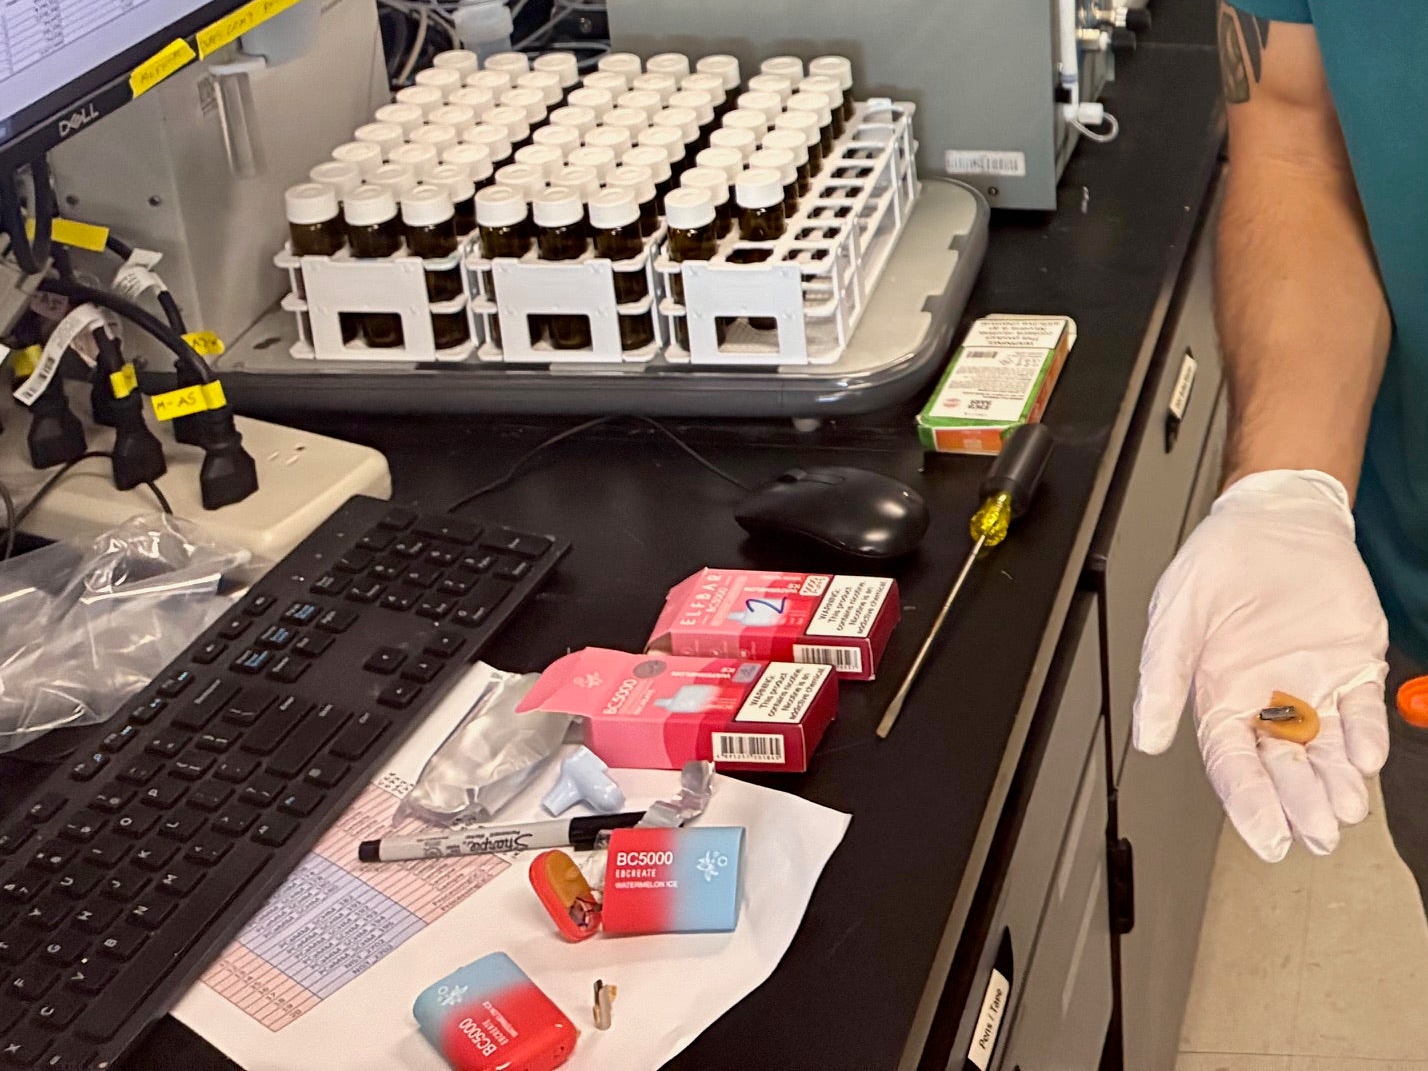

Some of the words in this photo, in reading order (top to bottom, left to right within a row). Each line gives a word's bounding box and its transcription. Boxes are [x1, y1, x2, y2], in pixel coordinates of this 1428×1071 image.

[59, 103, 99, 137] DELL
[759, 695, 772, 708] This
[616, 850, 674, 866] BC5000
[615, 868, 657, 878] EBCREATE
[614, 881, 665, 889] WATERMELON
[666, 880, 678, 888] ICE
[979, 1023, 993, 1049] Pens
[989, 989, 1003, 1013] Tape
[458, 1017, 497, 1057] BC5000
